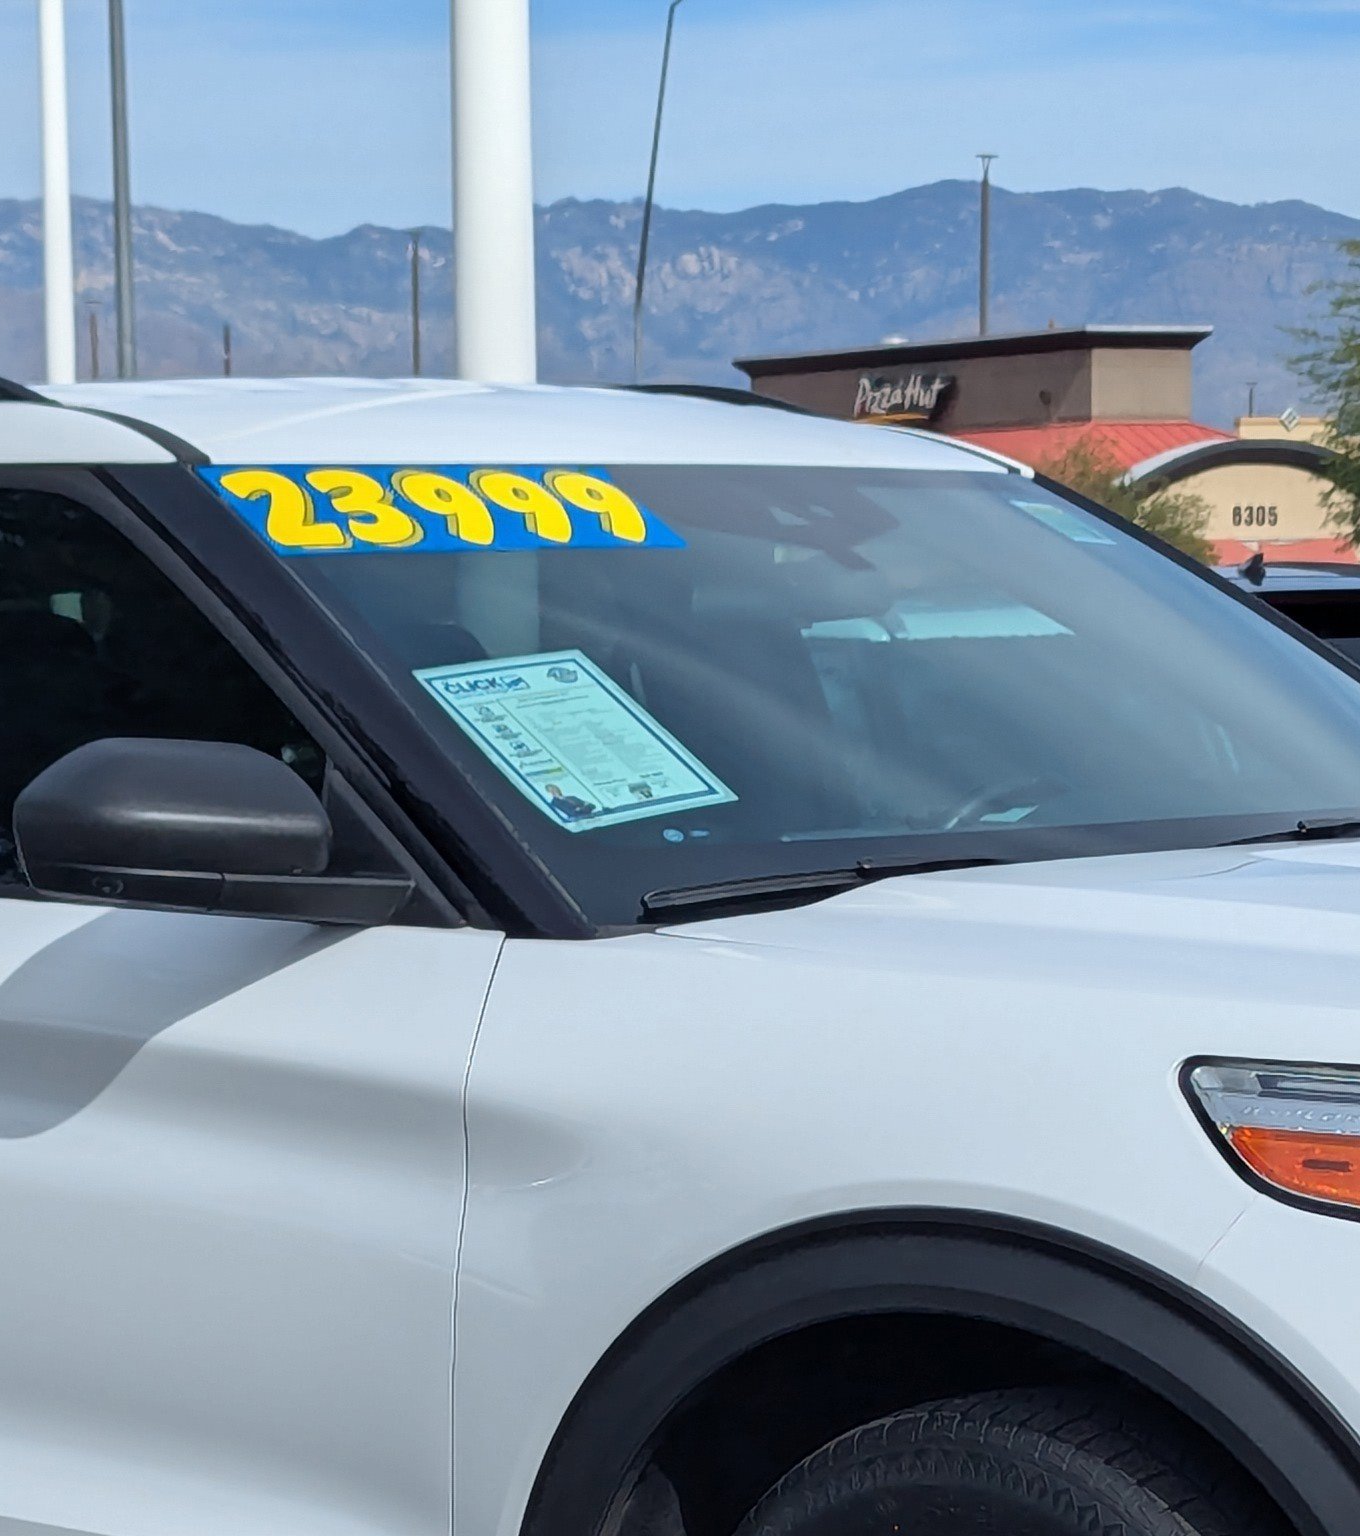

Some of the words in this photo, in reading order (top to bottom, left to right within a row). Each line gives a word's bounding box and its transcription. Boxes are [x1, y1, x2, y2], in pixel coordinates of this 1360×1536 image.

[853, 377, 904, 418] Pizza
[903, 373, 951, 412] Hut
[219, 468, 647, 548] 23999
[1232, 505, 1278, 527] 6305
[443, 677, 503, 695] CLICK
